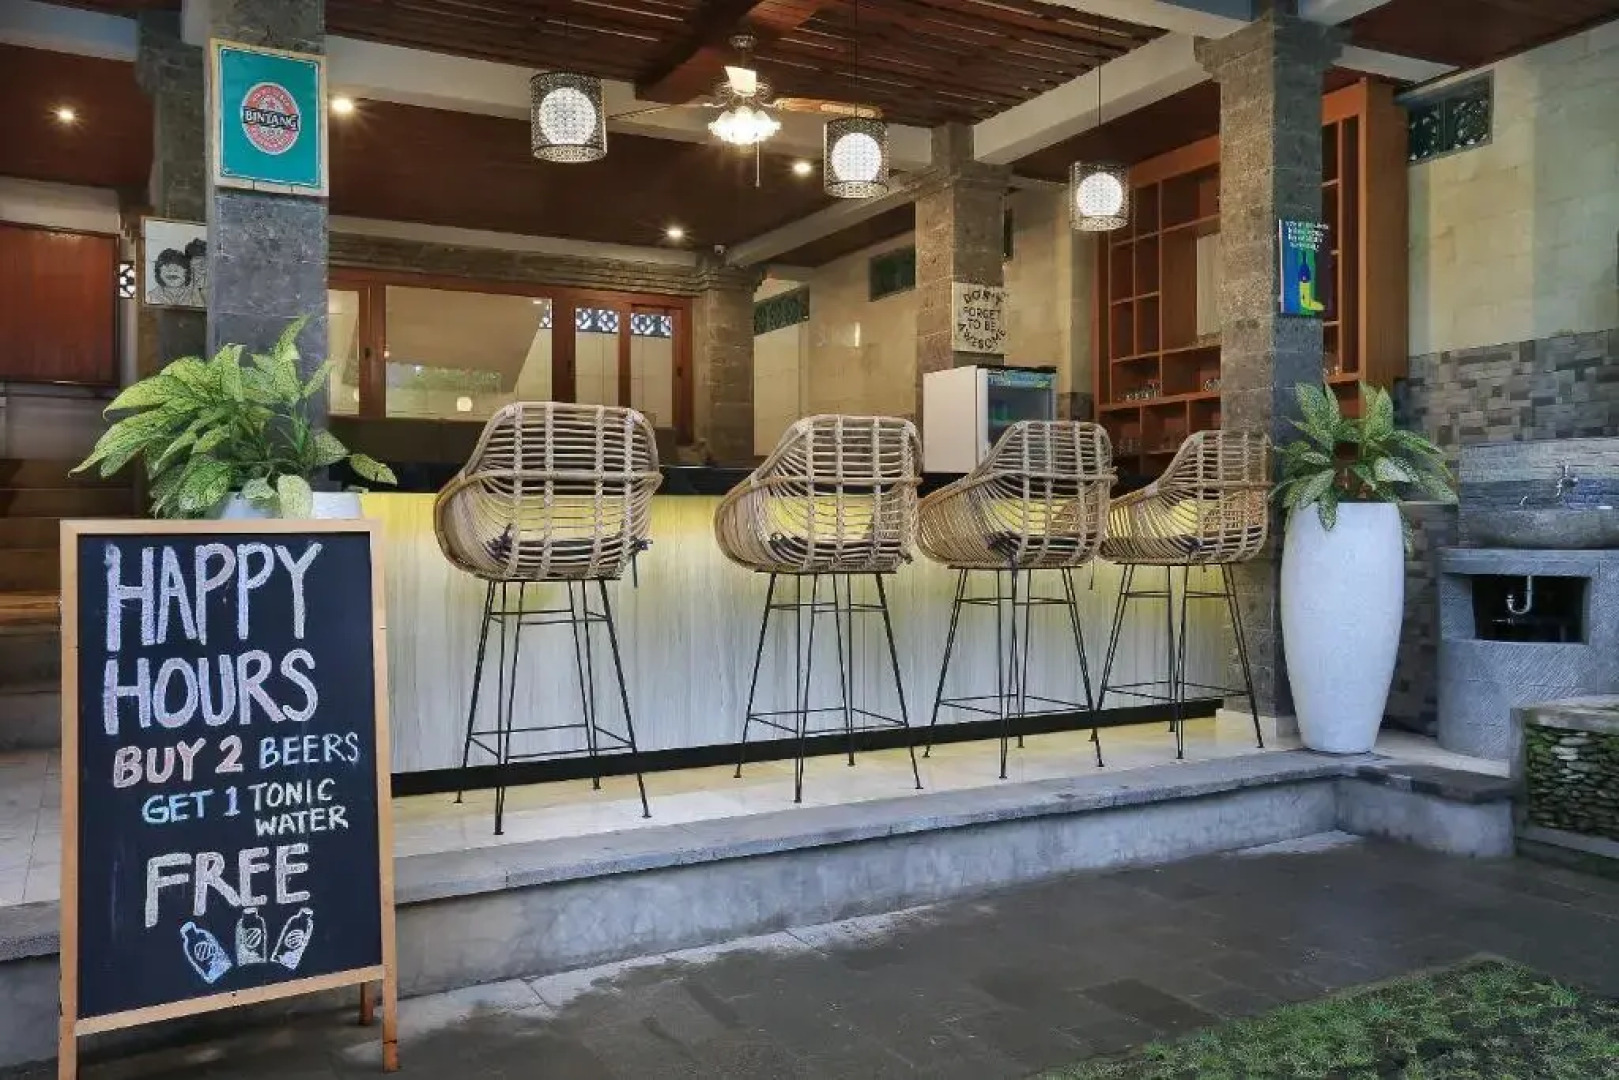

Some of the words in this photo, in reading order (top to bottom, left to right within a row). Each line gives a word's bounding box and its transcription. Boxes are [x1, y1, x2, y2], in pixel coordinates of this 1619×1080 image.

[245, 109, 298, 129] BINTANG
[963, 306, 1001, 319] FORGET
[967, 318, 981, 330] TO
[984, 320, 997, 332] BE
[104, 542, 322, 652] HAPPY
[102, 648, 320, 736] HOURS
[113, 736, 207, 788] BUY
[214, 734, 244, 774] 2
[258, 732, 361, 770] BEERS
[141, 788, 214, 824] GET
[221, 785, 241, 817] 1
[248, 778, 336, 812] TONIC
[254, 805, 349, 837] WATER
[144, 842, 311, 929] FREE
